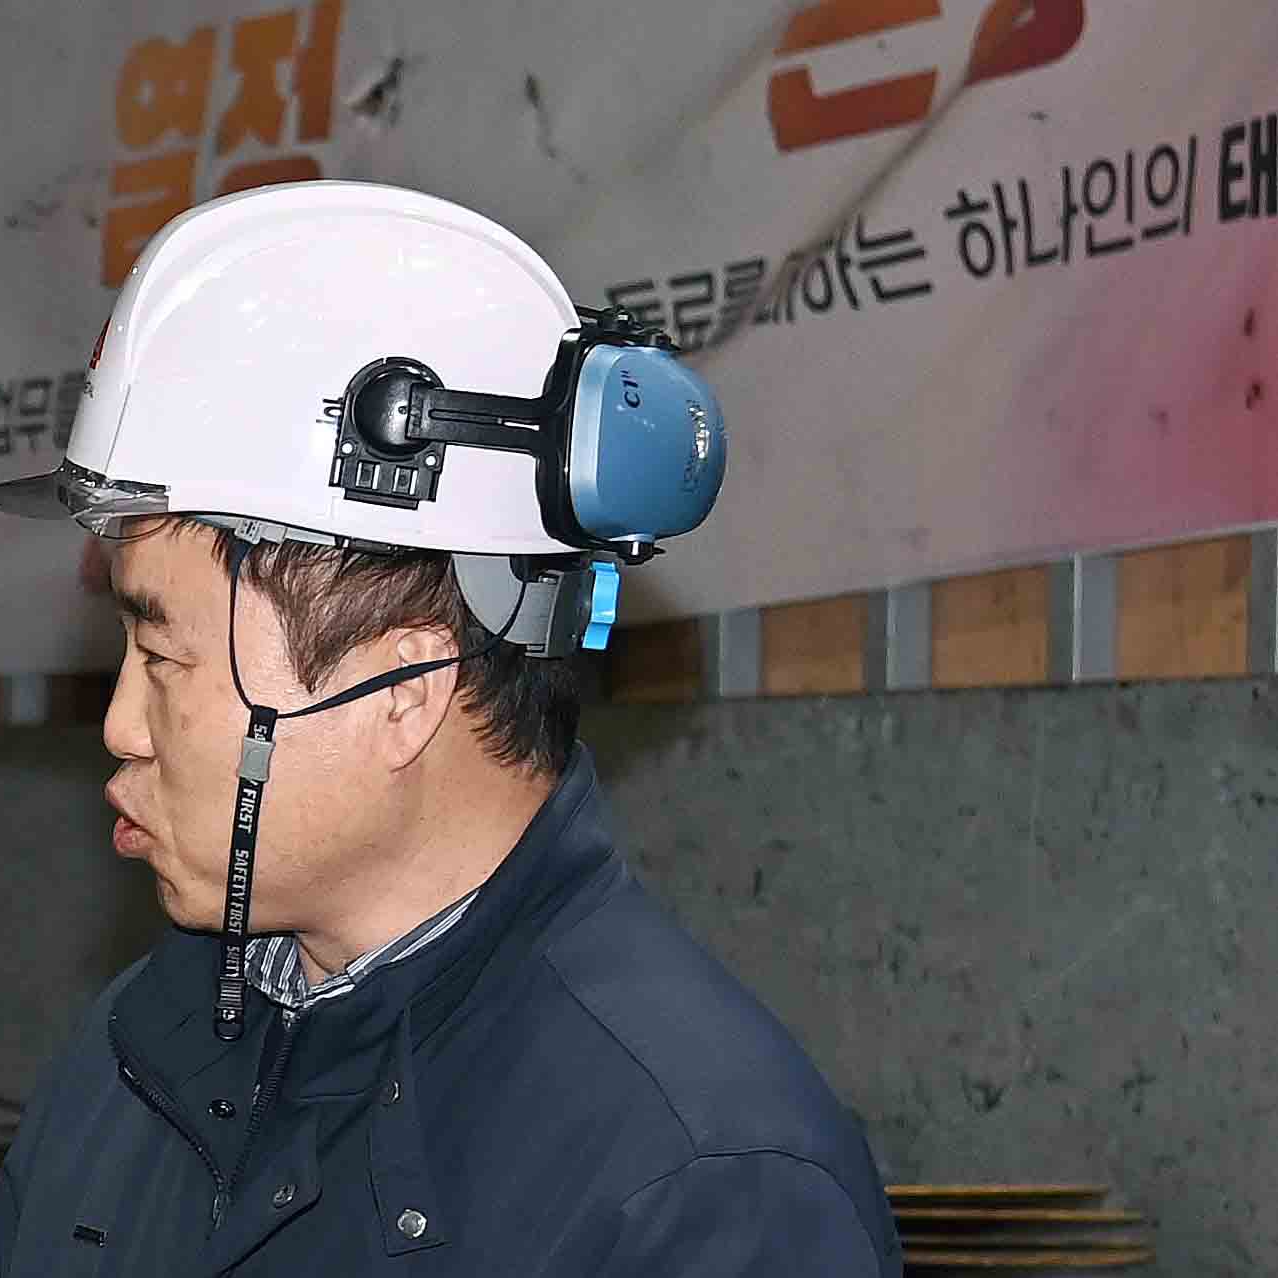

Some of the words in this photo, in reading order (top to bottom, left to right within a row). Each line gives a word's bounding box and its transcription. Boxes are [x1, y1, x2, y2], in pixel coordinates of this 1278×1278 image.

[944, 132, 1198, 279] 하나인의
[237, 788, 258, 835] FIRST
[232, 850, 250, 901] SAFETY
[227, 902, 244, 936] FIRST
